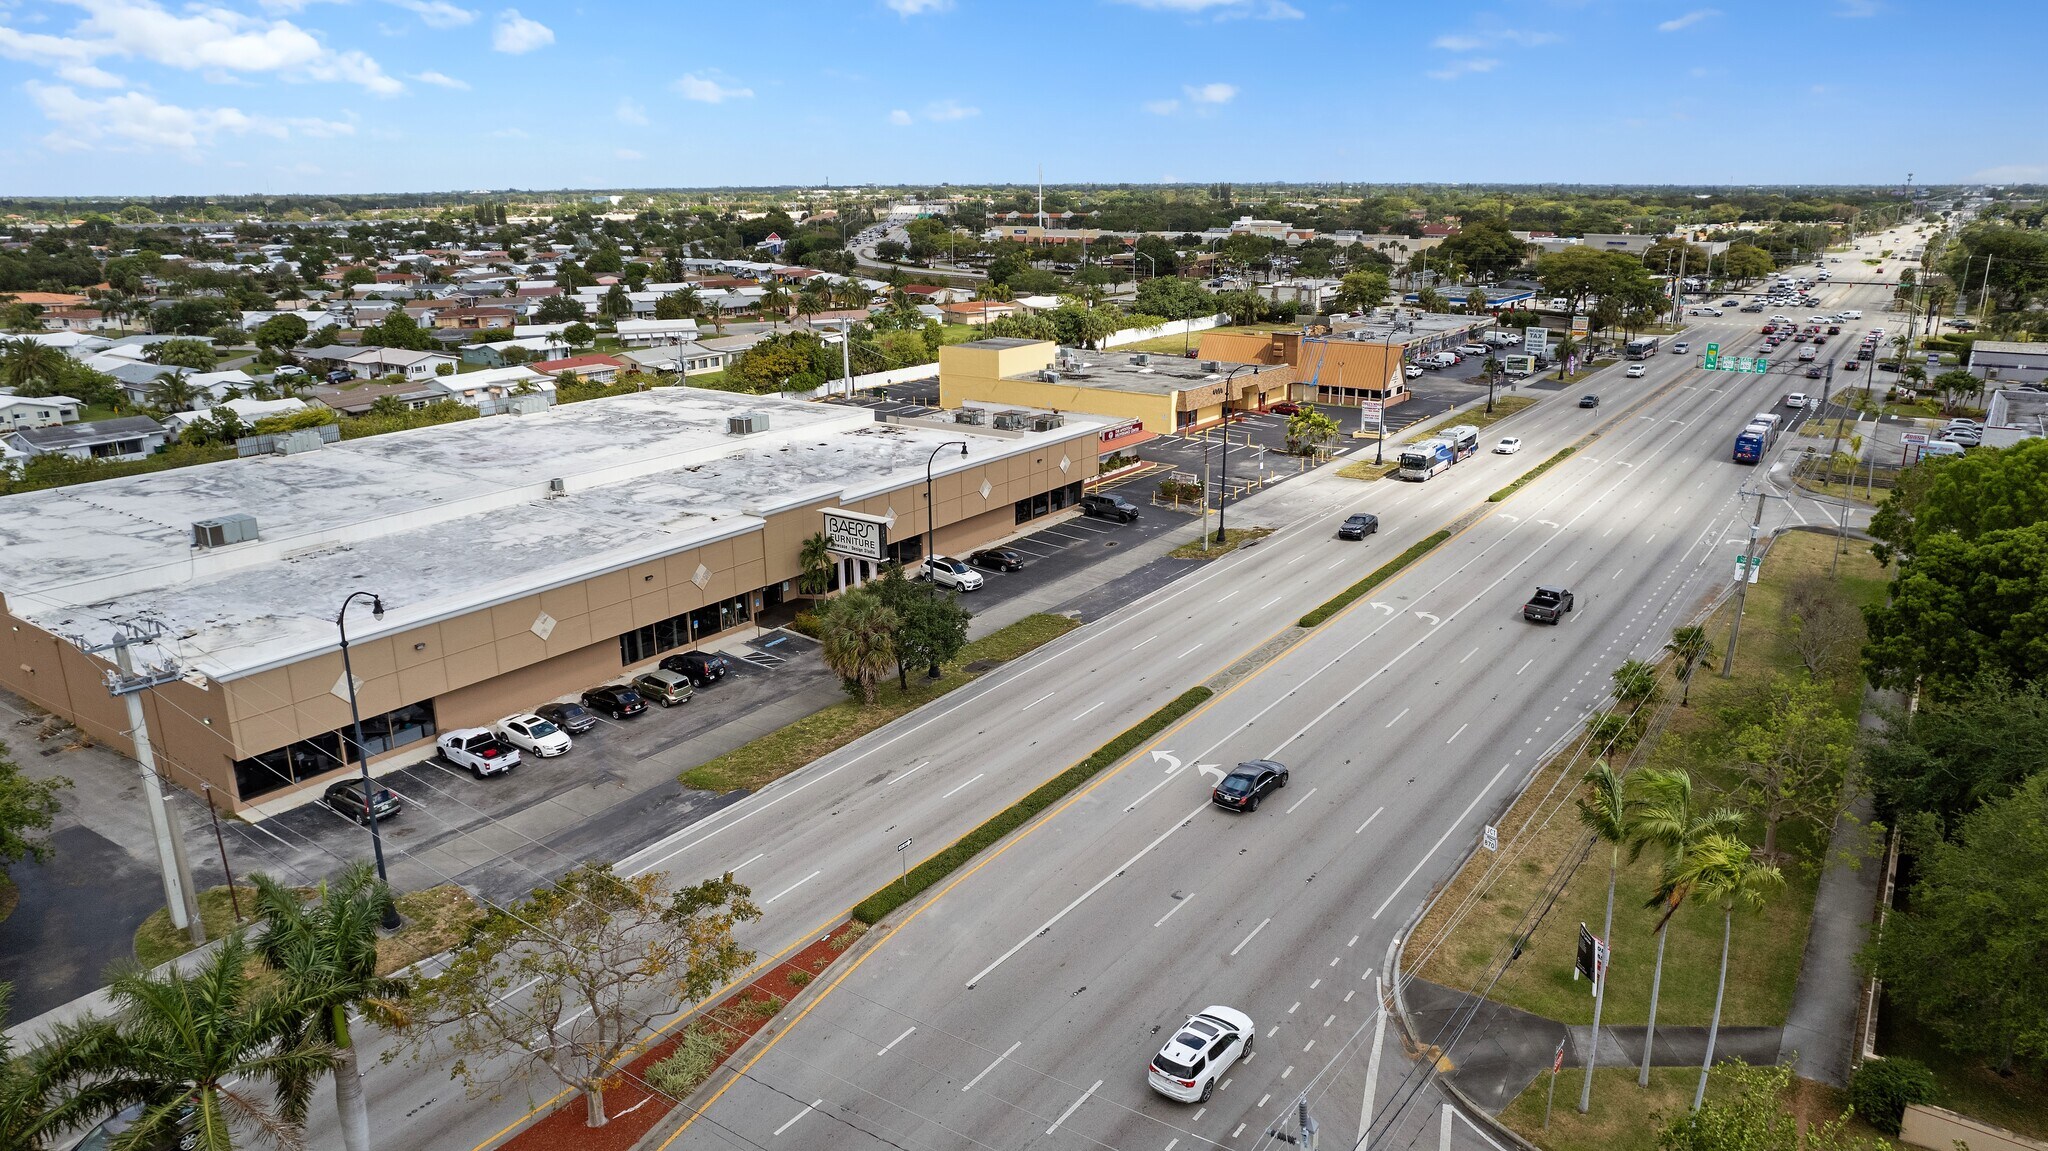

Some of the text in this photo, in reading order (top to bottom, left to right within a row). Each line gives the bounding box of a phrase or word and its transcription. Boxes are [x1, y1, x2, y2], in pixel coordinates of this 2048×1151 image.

[830, 518, 874, 538] BAER'S
[830, 533, 875, 550] FURNITURE
[851, 545, 863, 553] Design
[1487, 828, 1496, 836] JCT
